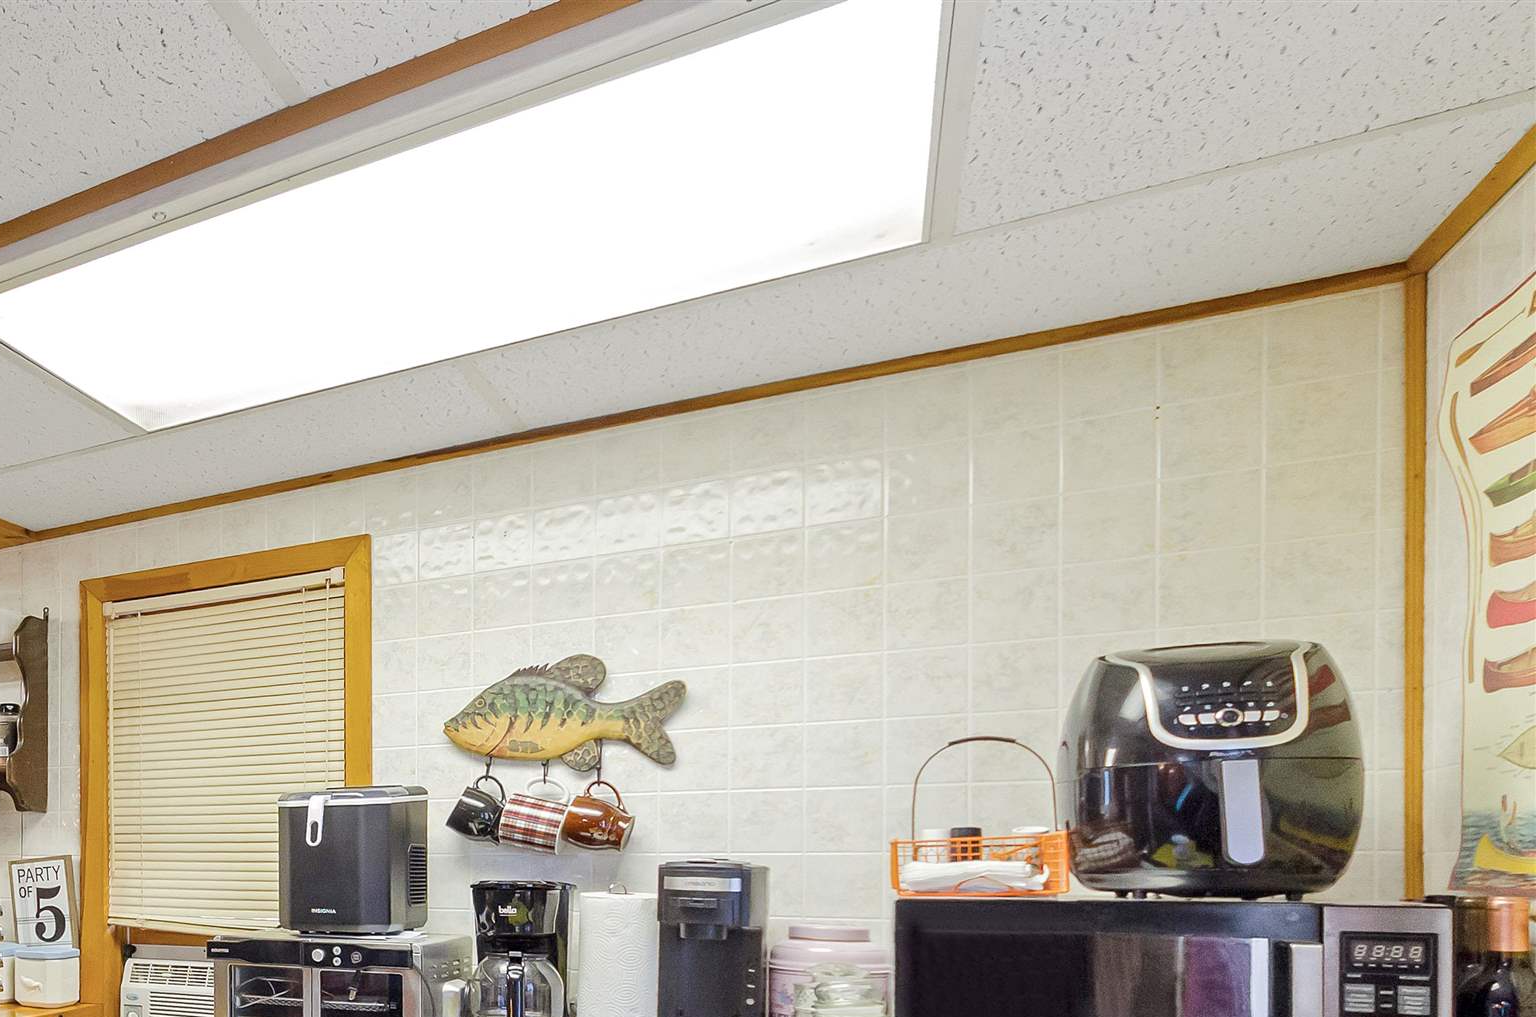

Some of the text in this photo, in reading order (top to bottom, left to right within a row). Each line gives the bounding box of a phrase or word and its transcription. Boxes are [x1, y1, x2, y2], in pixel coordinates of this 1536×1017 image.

[17, 865, 60, 883] PARTY
[19, 885, 66, 943] OF 5
[498, 905, 518, 914] bella
